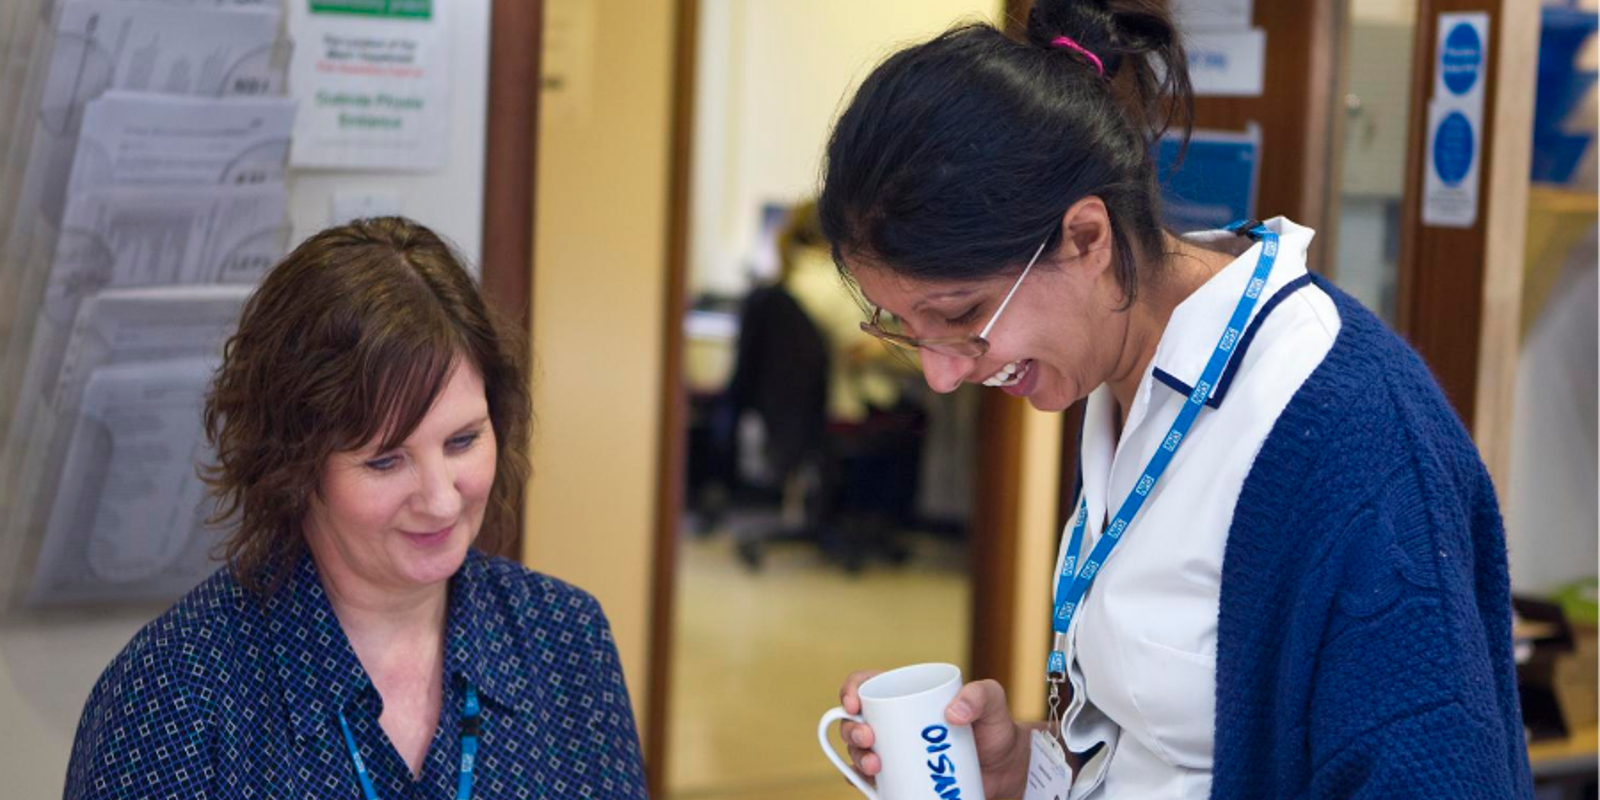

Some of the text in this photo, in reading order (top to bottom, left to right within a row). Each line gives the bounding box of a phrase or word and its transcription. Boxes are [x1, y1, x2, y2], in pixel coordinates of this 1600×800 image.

[1219, 327, 1239, 352] NHS
[1191, 380, 1210, 405] NHS
[1163, 430, 1182, 451] NHS
[1136, 474, 1154, 496] NHS
[1108, 519, 1127, 539] NHS
[1080, 560, 1099, 580] NHS
